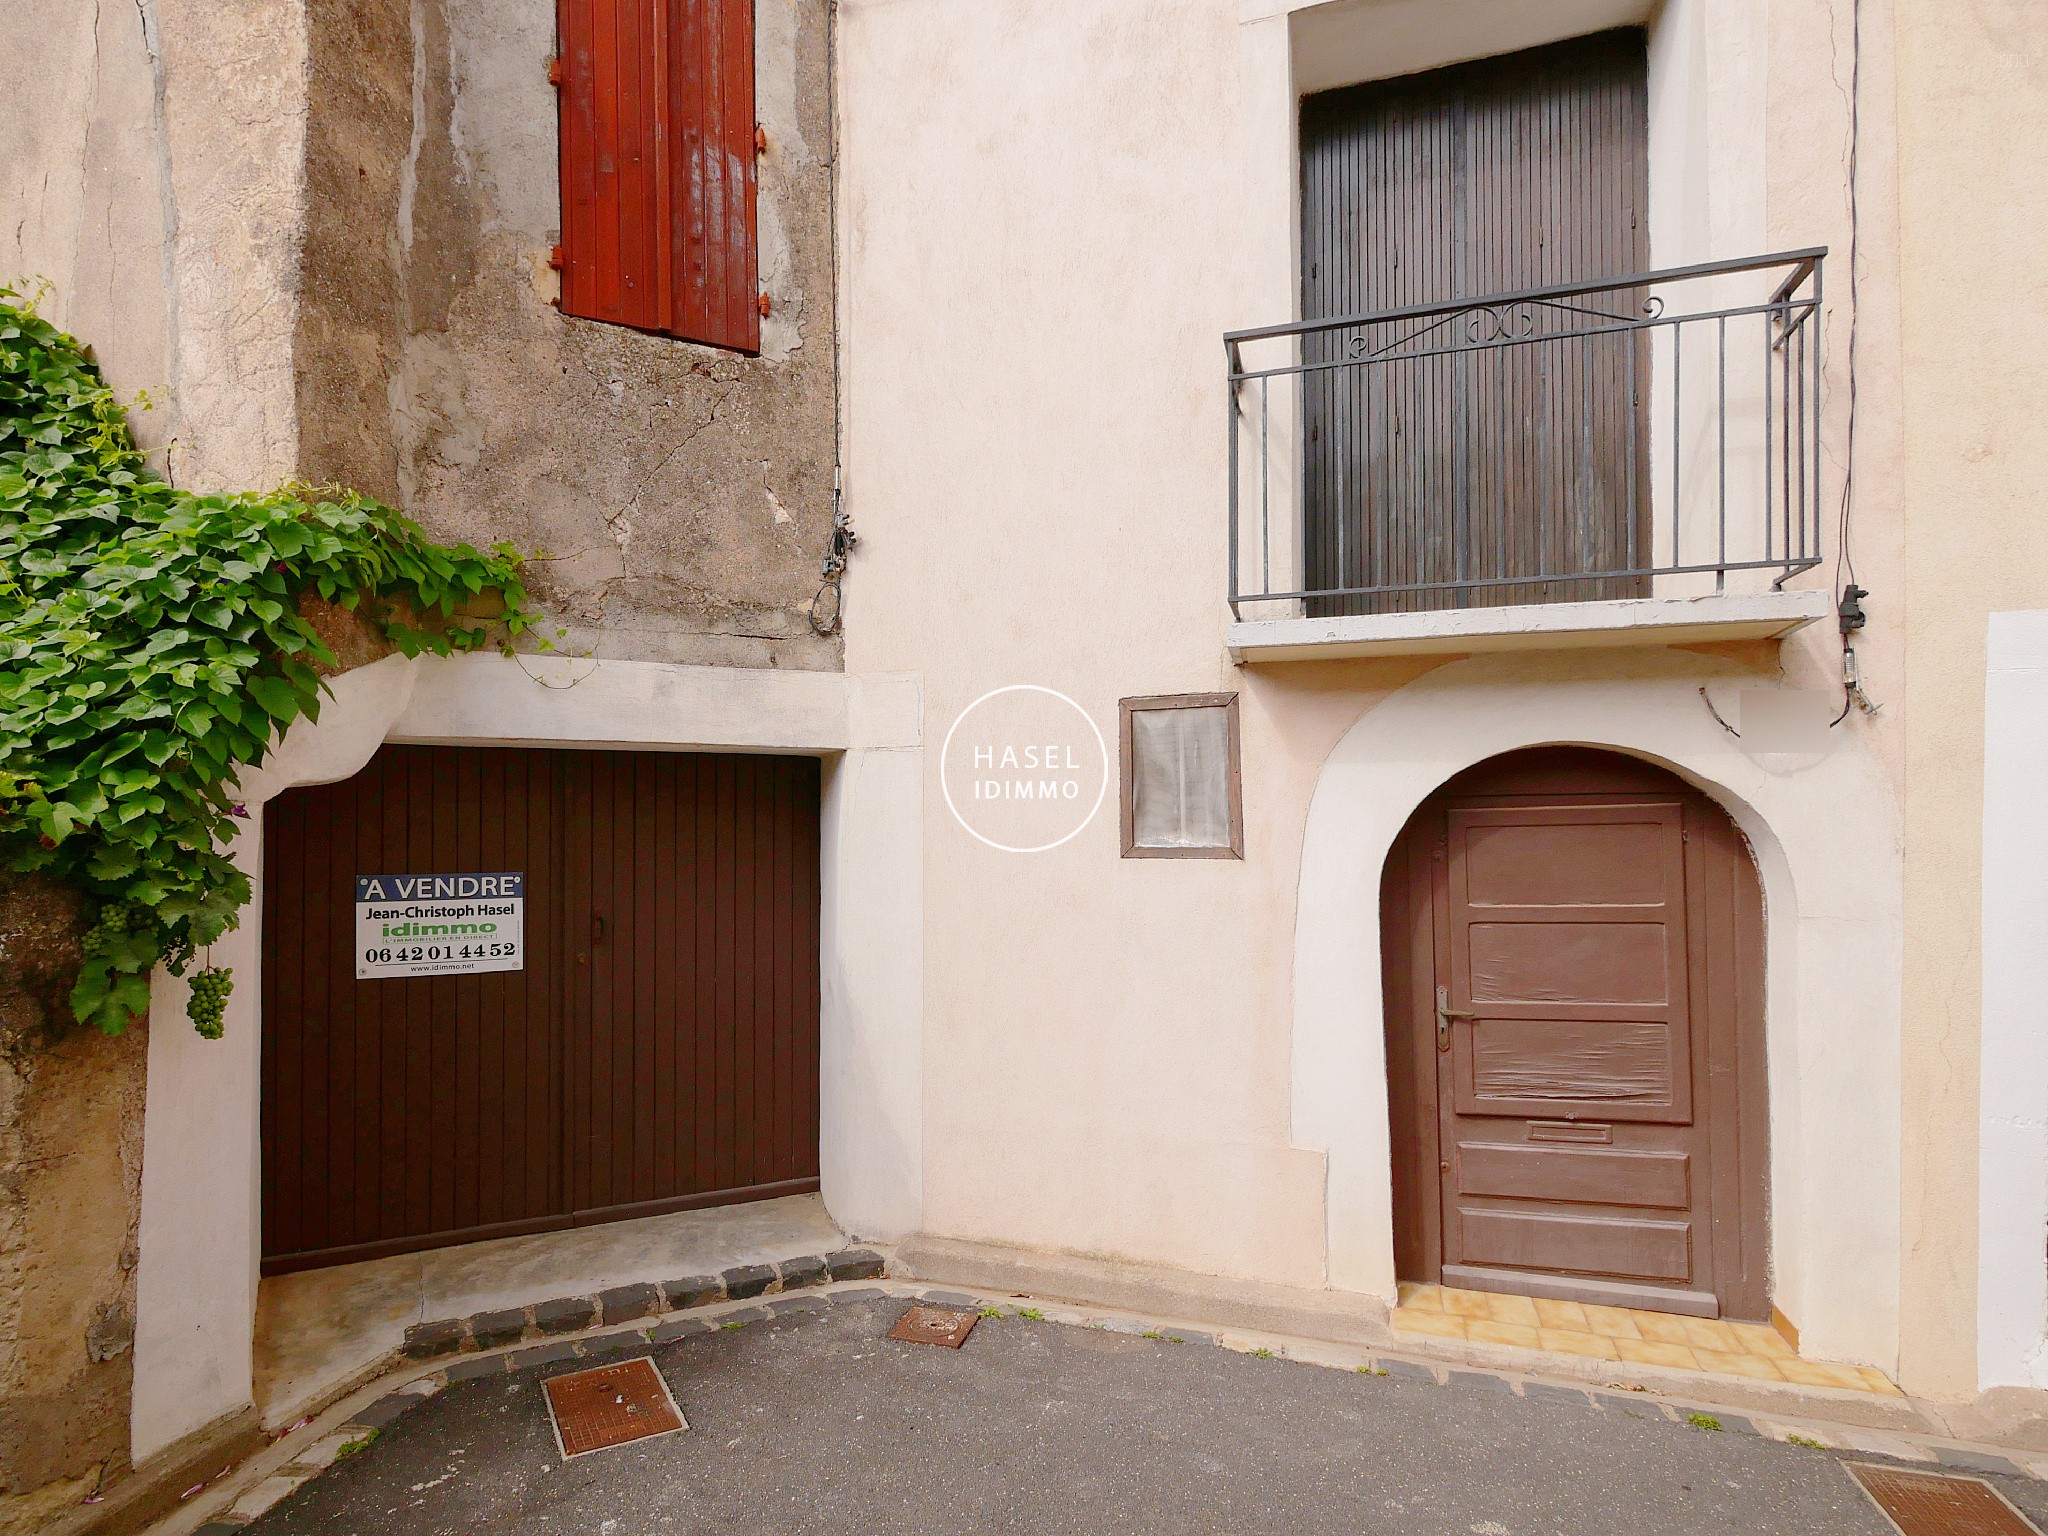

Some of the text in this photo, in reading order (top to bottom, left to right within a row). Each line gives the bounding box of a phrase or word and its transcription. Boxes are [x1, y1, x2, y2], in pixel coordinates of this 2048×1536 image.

[365, 876, 515, 900] A VENDRE
[365, 903, 514, 920] Jean-Christoph Hasel
[382, 922, 497, 937] idimmo
[411, 963, 474, 972] www.idimmo.net
